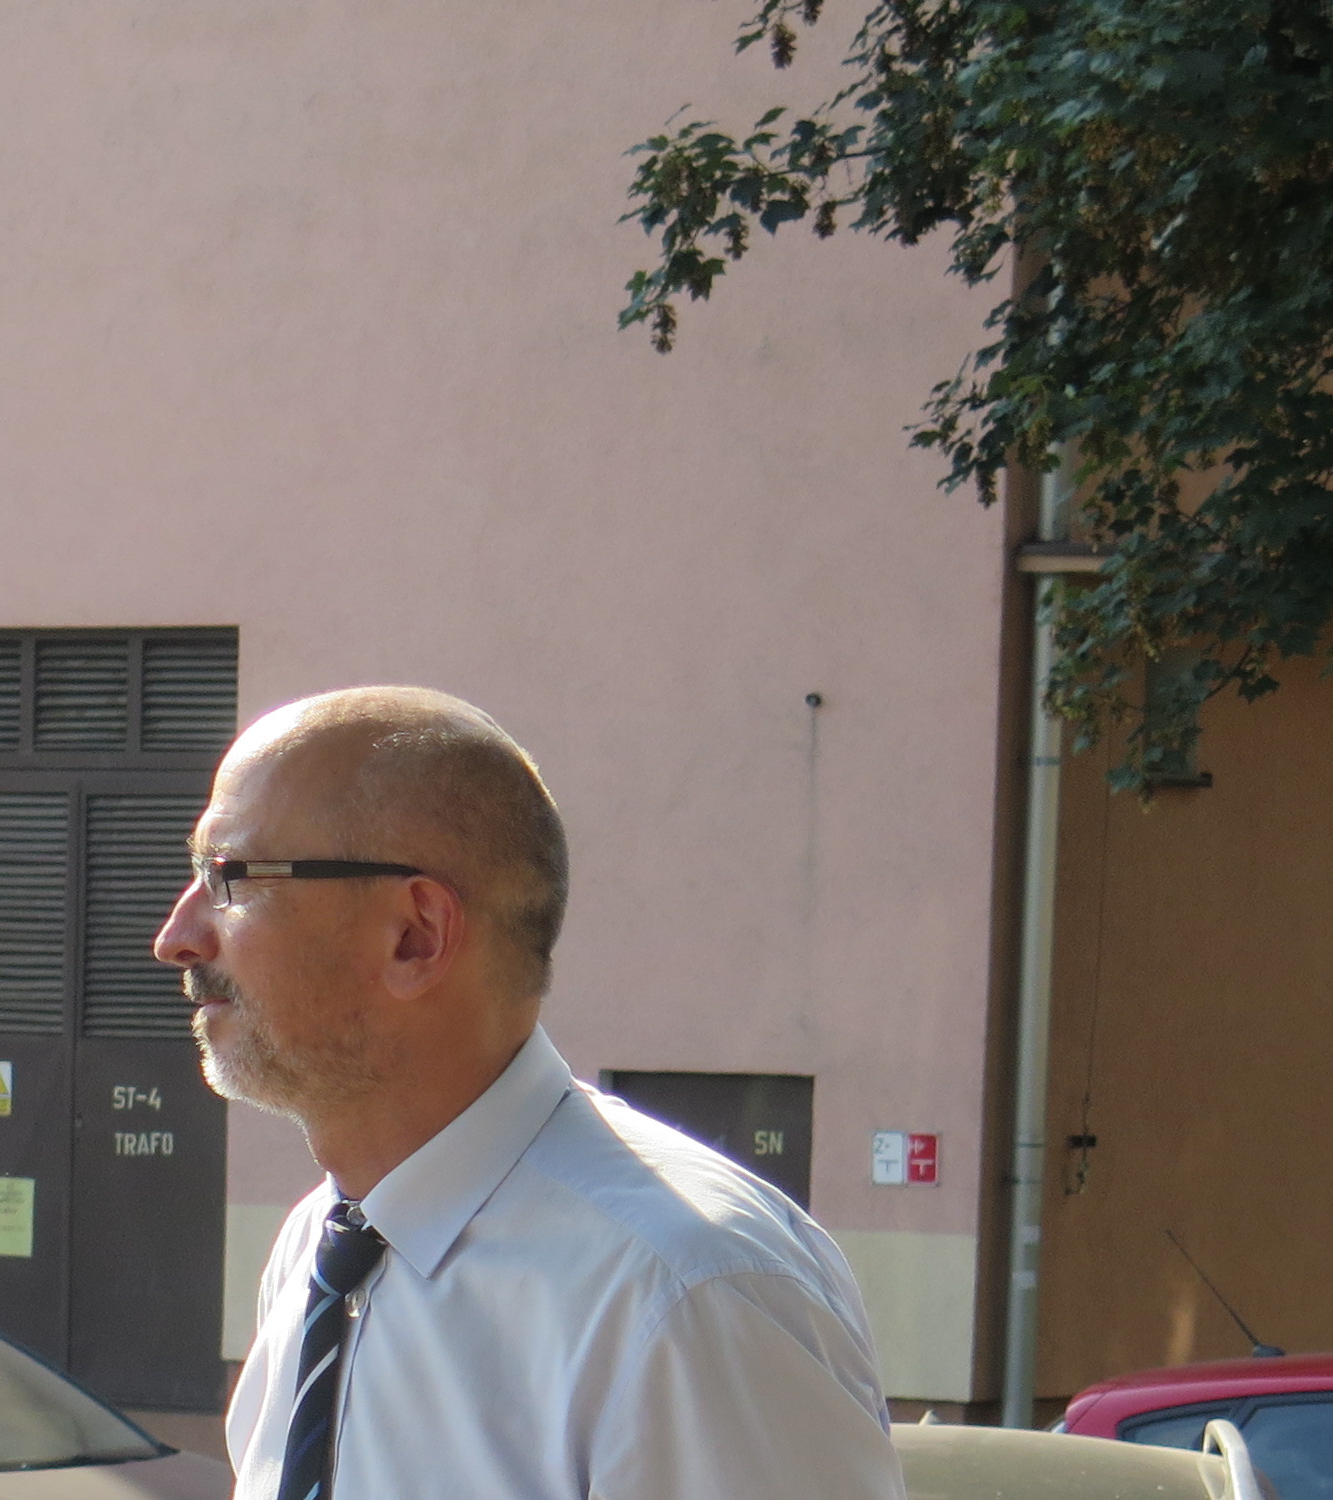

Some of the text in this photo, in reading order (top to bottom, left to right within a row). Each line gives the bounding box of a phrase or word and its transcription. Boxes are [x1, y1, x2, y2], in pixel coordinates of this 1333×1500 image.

[113, 1085, 163, 1111] ST-4
[114, 1131, 174, 1157] TRAFO
[754, 1130, 784, 1156] SN
